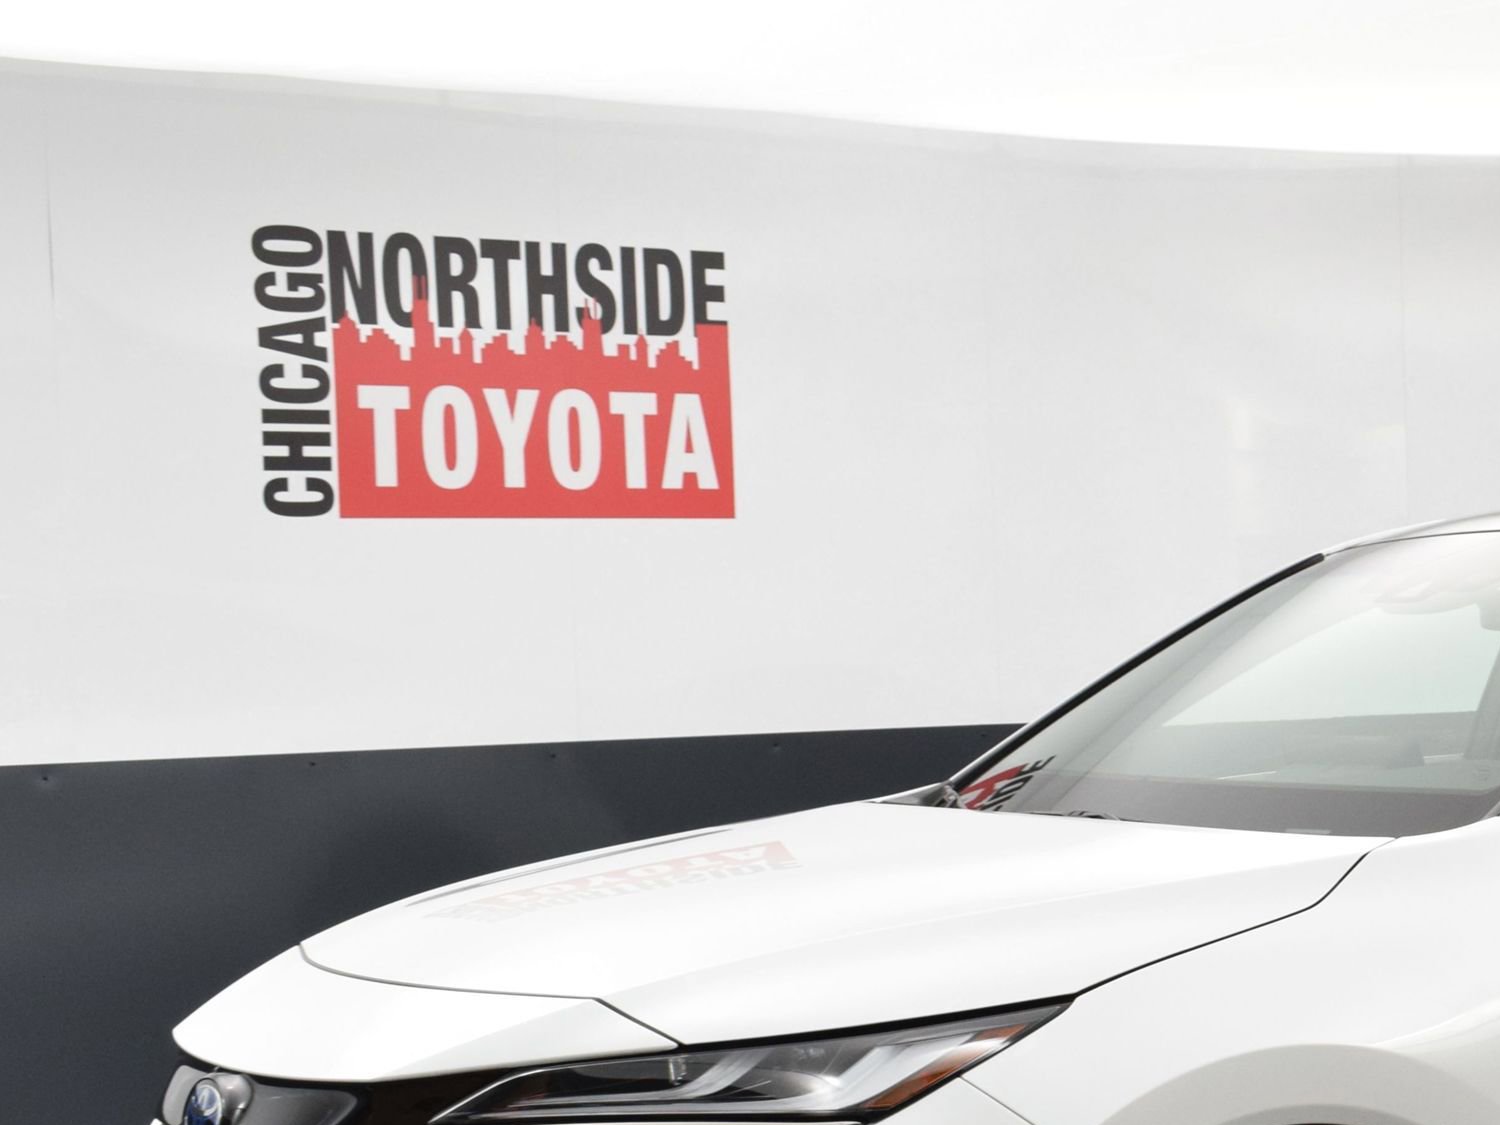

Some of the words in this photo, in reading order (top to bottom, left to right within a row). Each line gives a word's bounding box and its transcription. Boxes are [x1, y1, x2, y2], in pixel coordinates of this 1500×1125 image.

[326, 229, 729, 337] NORTHSIDE
[251, 224, 334, 518] CHICAGO
[357, 384, 720, 491] TOYOTA
